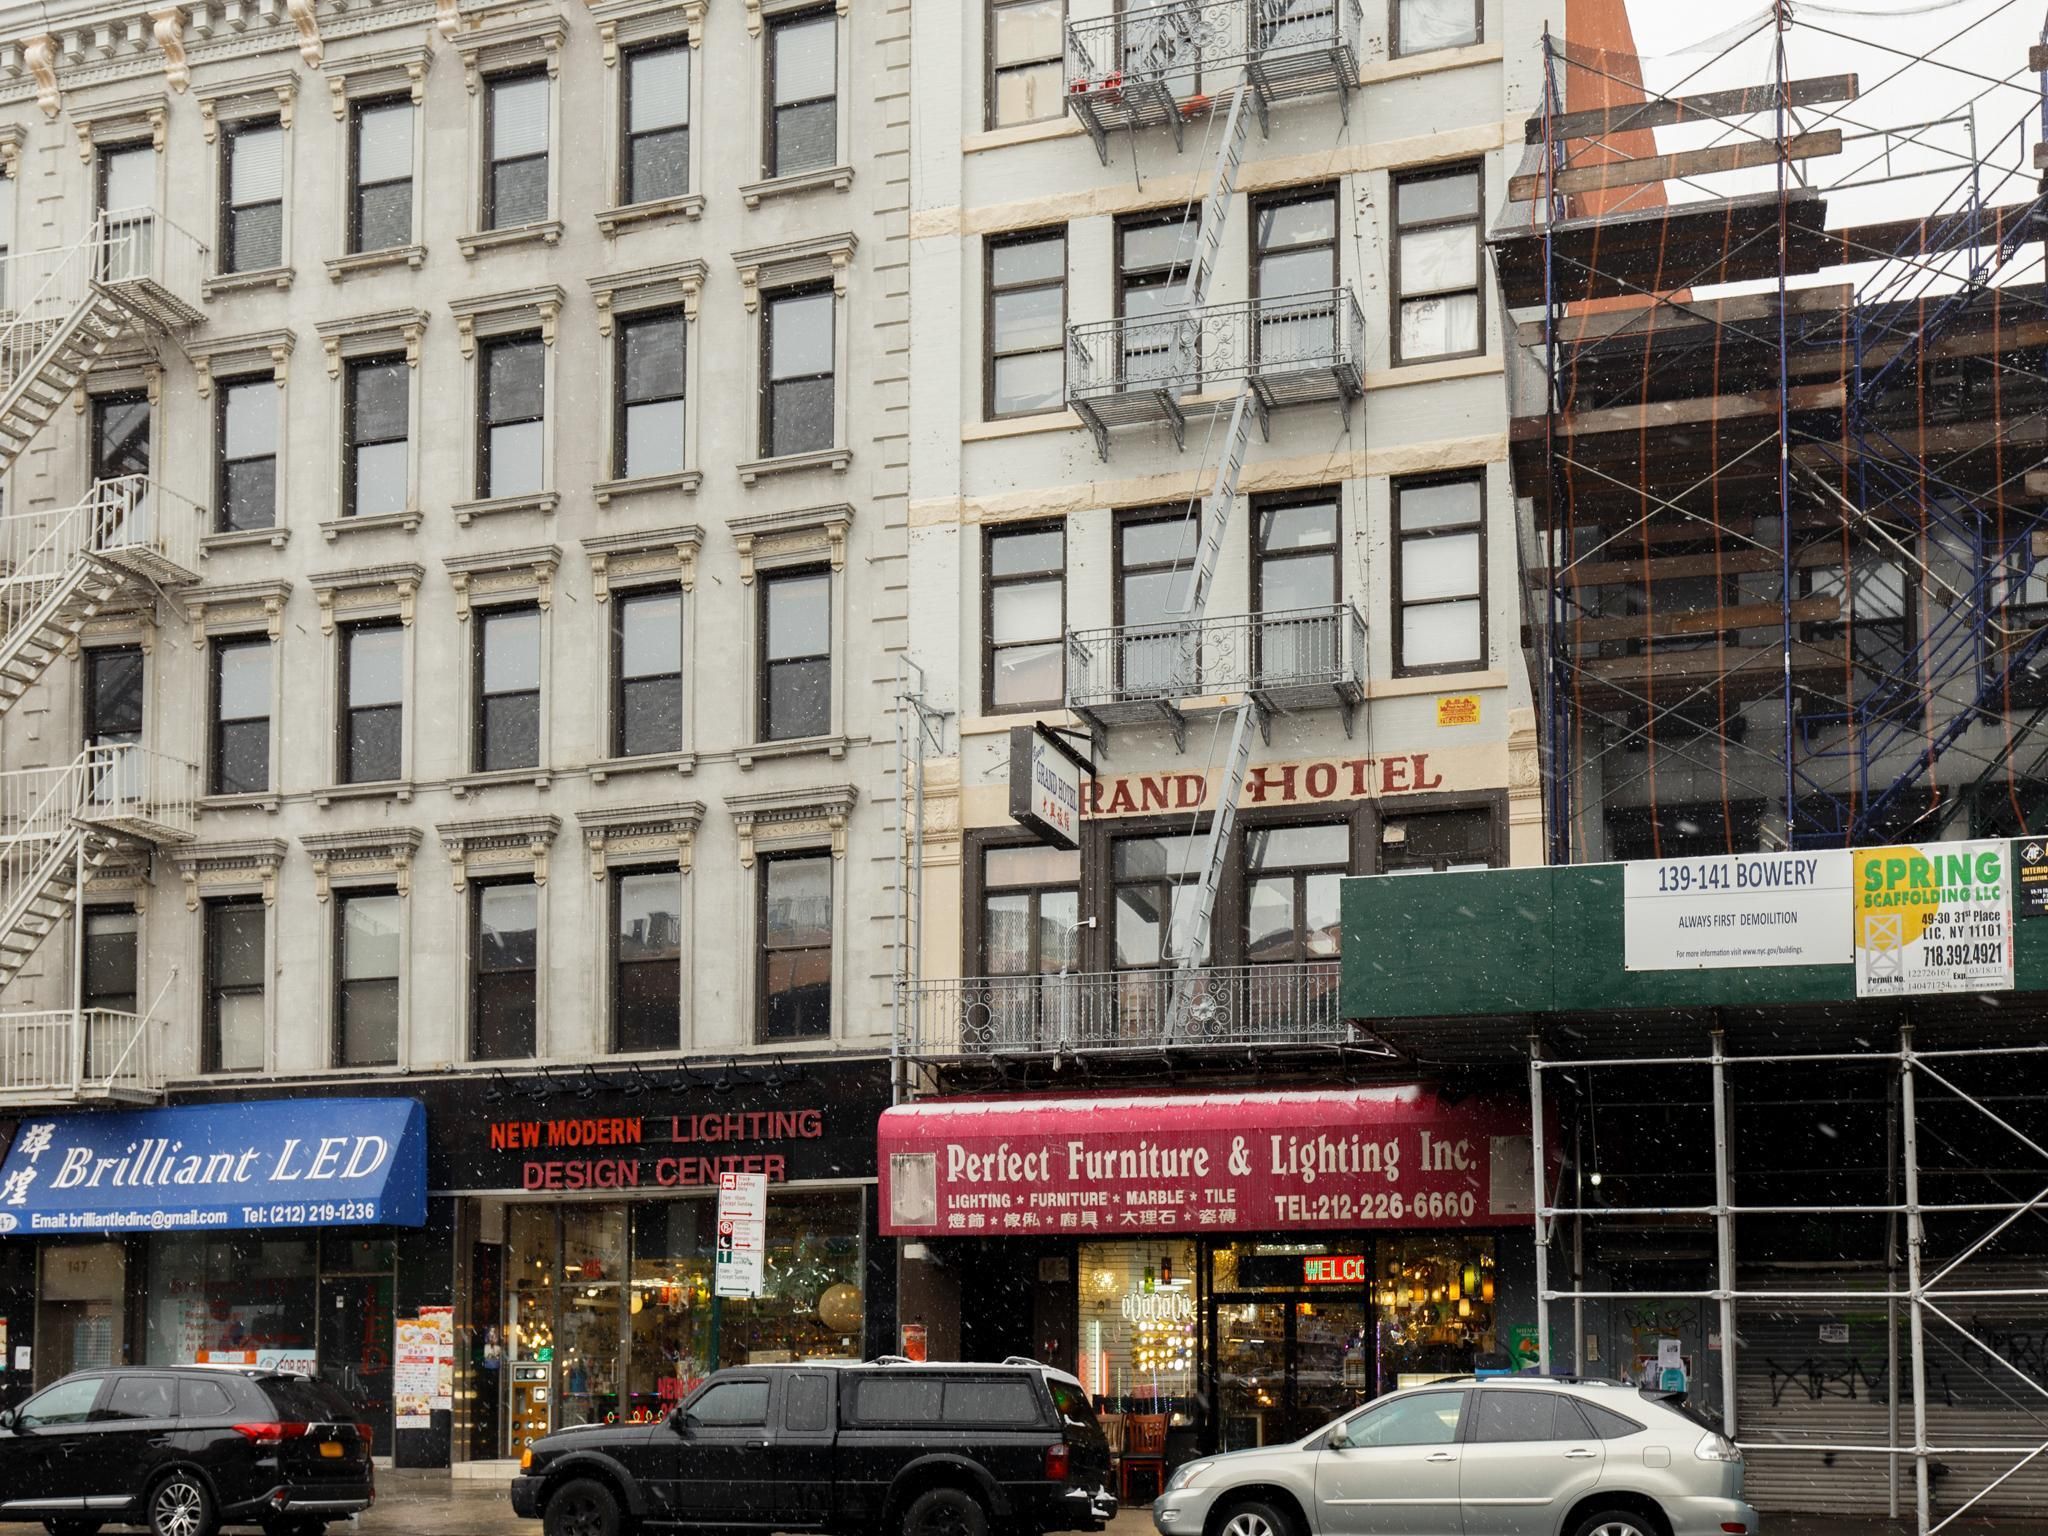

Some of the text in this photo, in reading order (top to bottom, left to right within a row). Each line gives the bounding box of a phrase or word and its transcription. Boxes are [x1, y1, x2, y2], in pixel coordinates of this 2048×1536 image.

[1037, 760, 1077, 811] GRAND HOTEL
[1079, 774, 1207, 815] RAND
[1245, 753, 1443, 803] HOTEL
[1658, 859, 1818, 891] 139-141 BOWERY
[1864, 852, 2001, 892] SPRING
[1864, 886, 2001, 908] SCAFFOLDING LLC
[1678, 911, 1798, 929] ALWAYS FIRST DEMOILITION
[1921, 909, 2001, 925] 49-30 31st Place
[1923, 924, 2001, 940] LIC, NY 11101
[1676, 950, 1685, 958] For
[1700, 948, 1730, 957] information
[1731, 948, 1742, 956] visit
[1923, 942, 2002, 967] 718.392.4921
[1867, 966, 2003, 985] Permit No. 122726167 Exp. 03/18/17
[490, 1109, 823, 1149] NEW MODERN LIGHTING
[49, 1135, 388, 1189] Brilliant LED
[947, 1131, 1477, 1184] Perfect Furniture & Lighting Inc.
[523, 1154, 786, 1191] DESIGN CENTER
[948, 1188, 1236, 1209] LIGHTING FURNITURE MARBLE TILE
[31, 1209, 228, 1230] Email: brilliantledinc@gmail.com
[242, 1203, 375, 1224] Tel: (212) 219-1236
[1120, 1210, 1177, 1226] 大理石
[69, 1260, 88, 1273] 147
